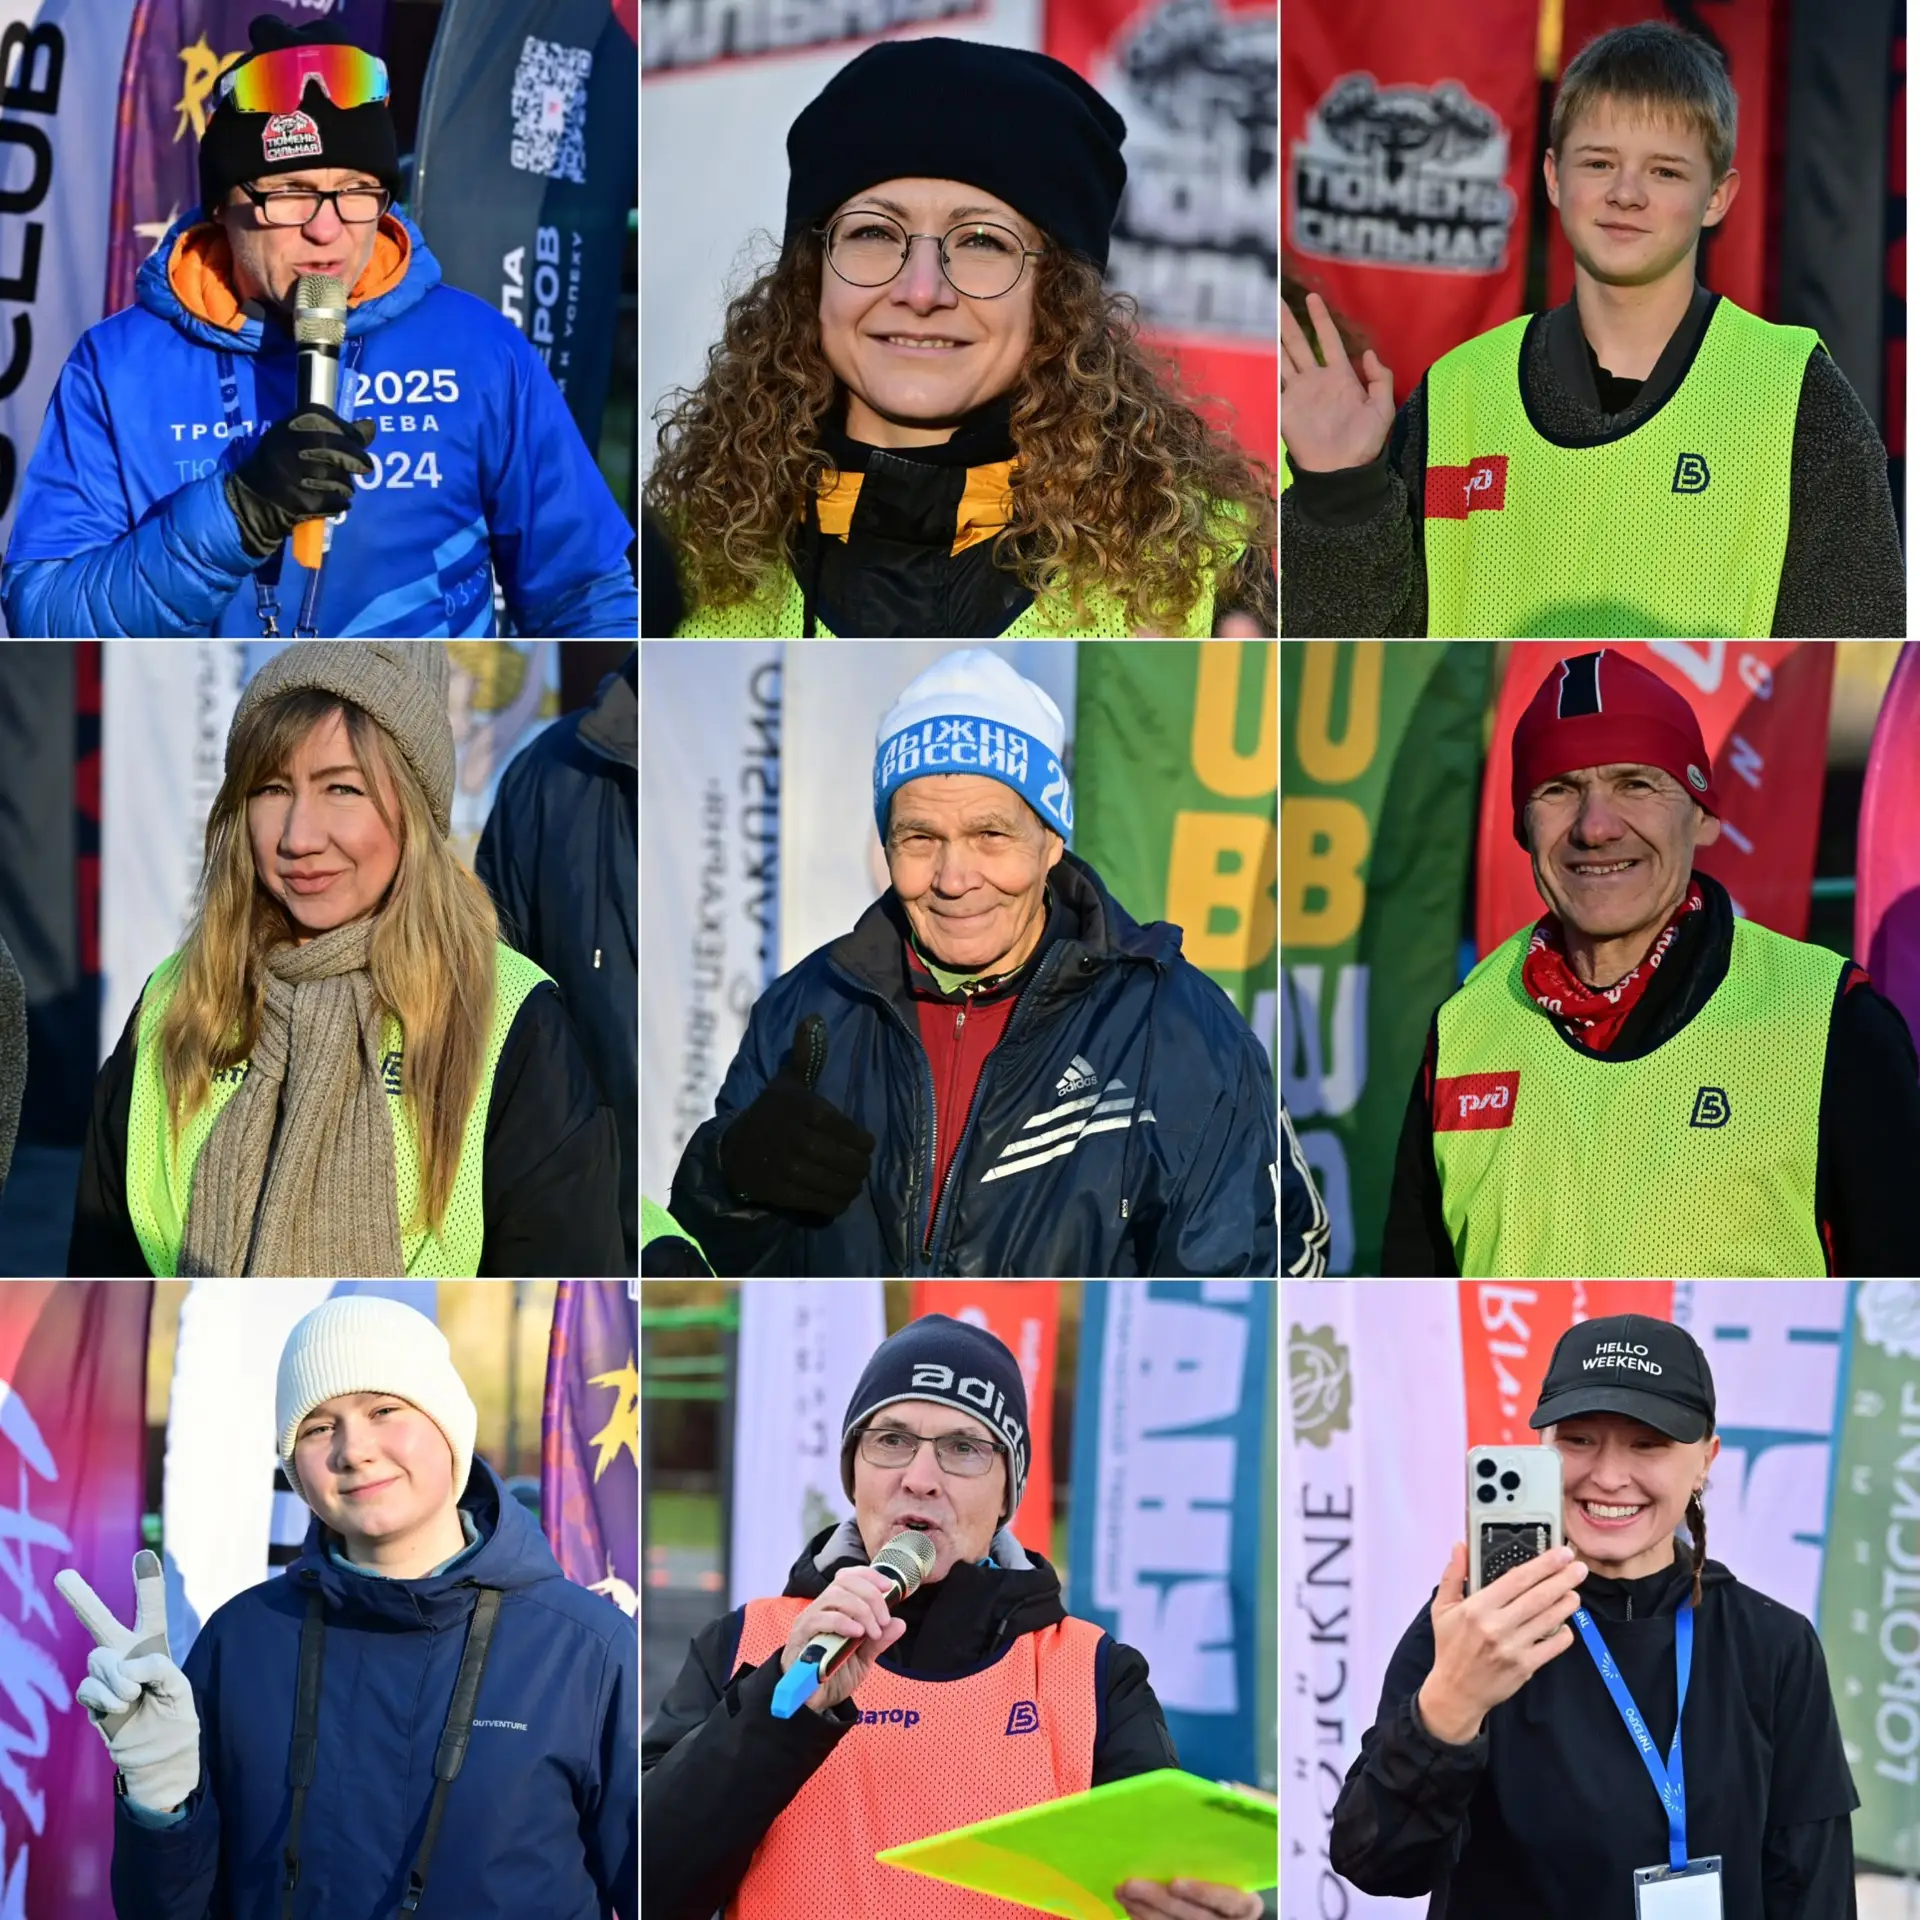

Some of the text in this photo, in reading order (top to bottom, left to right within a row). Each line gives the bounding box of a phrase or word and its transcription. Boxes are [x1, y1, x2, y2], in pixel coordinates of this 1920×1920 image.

[267, 133, 316, 148] ТЮМЕНЬ
[267, 144, 319, 158] СИЛЬНАЯ
[502, 245, 525, 329] ЛА
[354, 369, 459, 407] 2025
[364, 414, 440, 432] ЕВА
[352, 452, 442, 490] 024
[882, 719, 1028, 768] ЛЫЖНЯ
[881, 742, 1028, 789] РОССИИ
[1040, 759, 1074, 831] 20
[1058, 1075, 1098, 1098] adidas
[1595, 1342, 1649, 1356] HELLO
[1582, 1355, 1663, 1376] WEEKEND
[472, 1719, 528, 1731] OUTVENTURE
